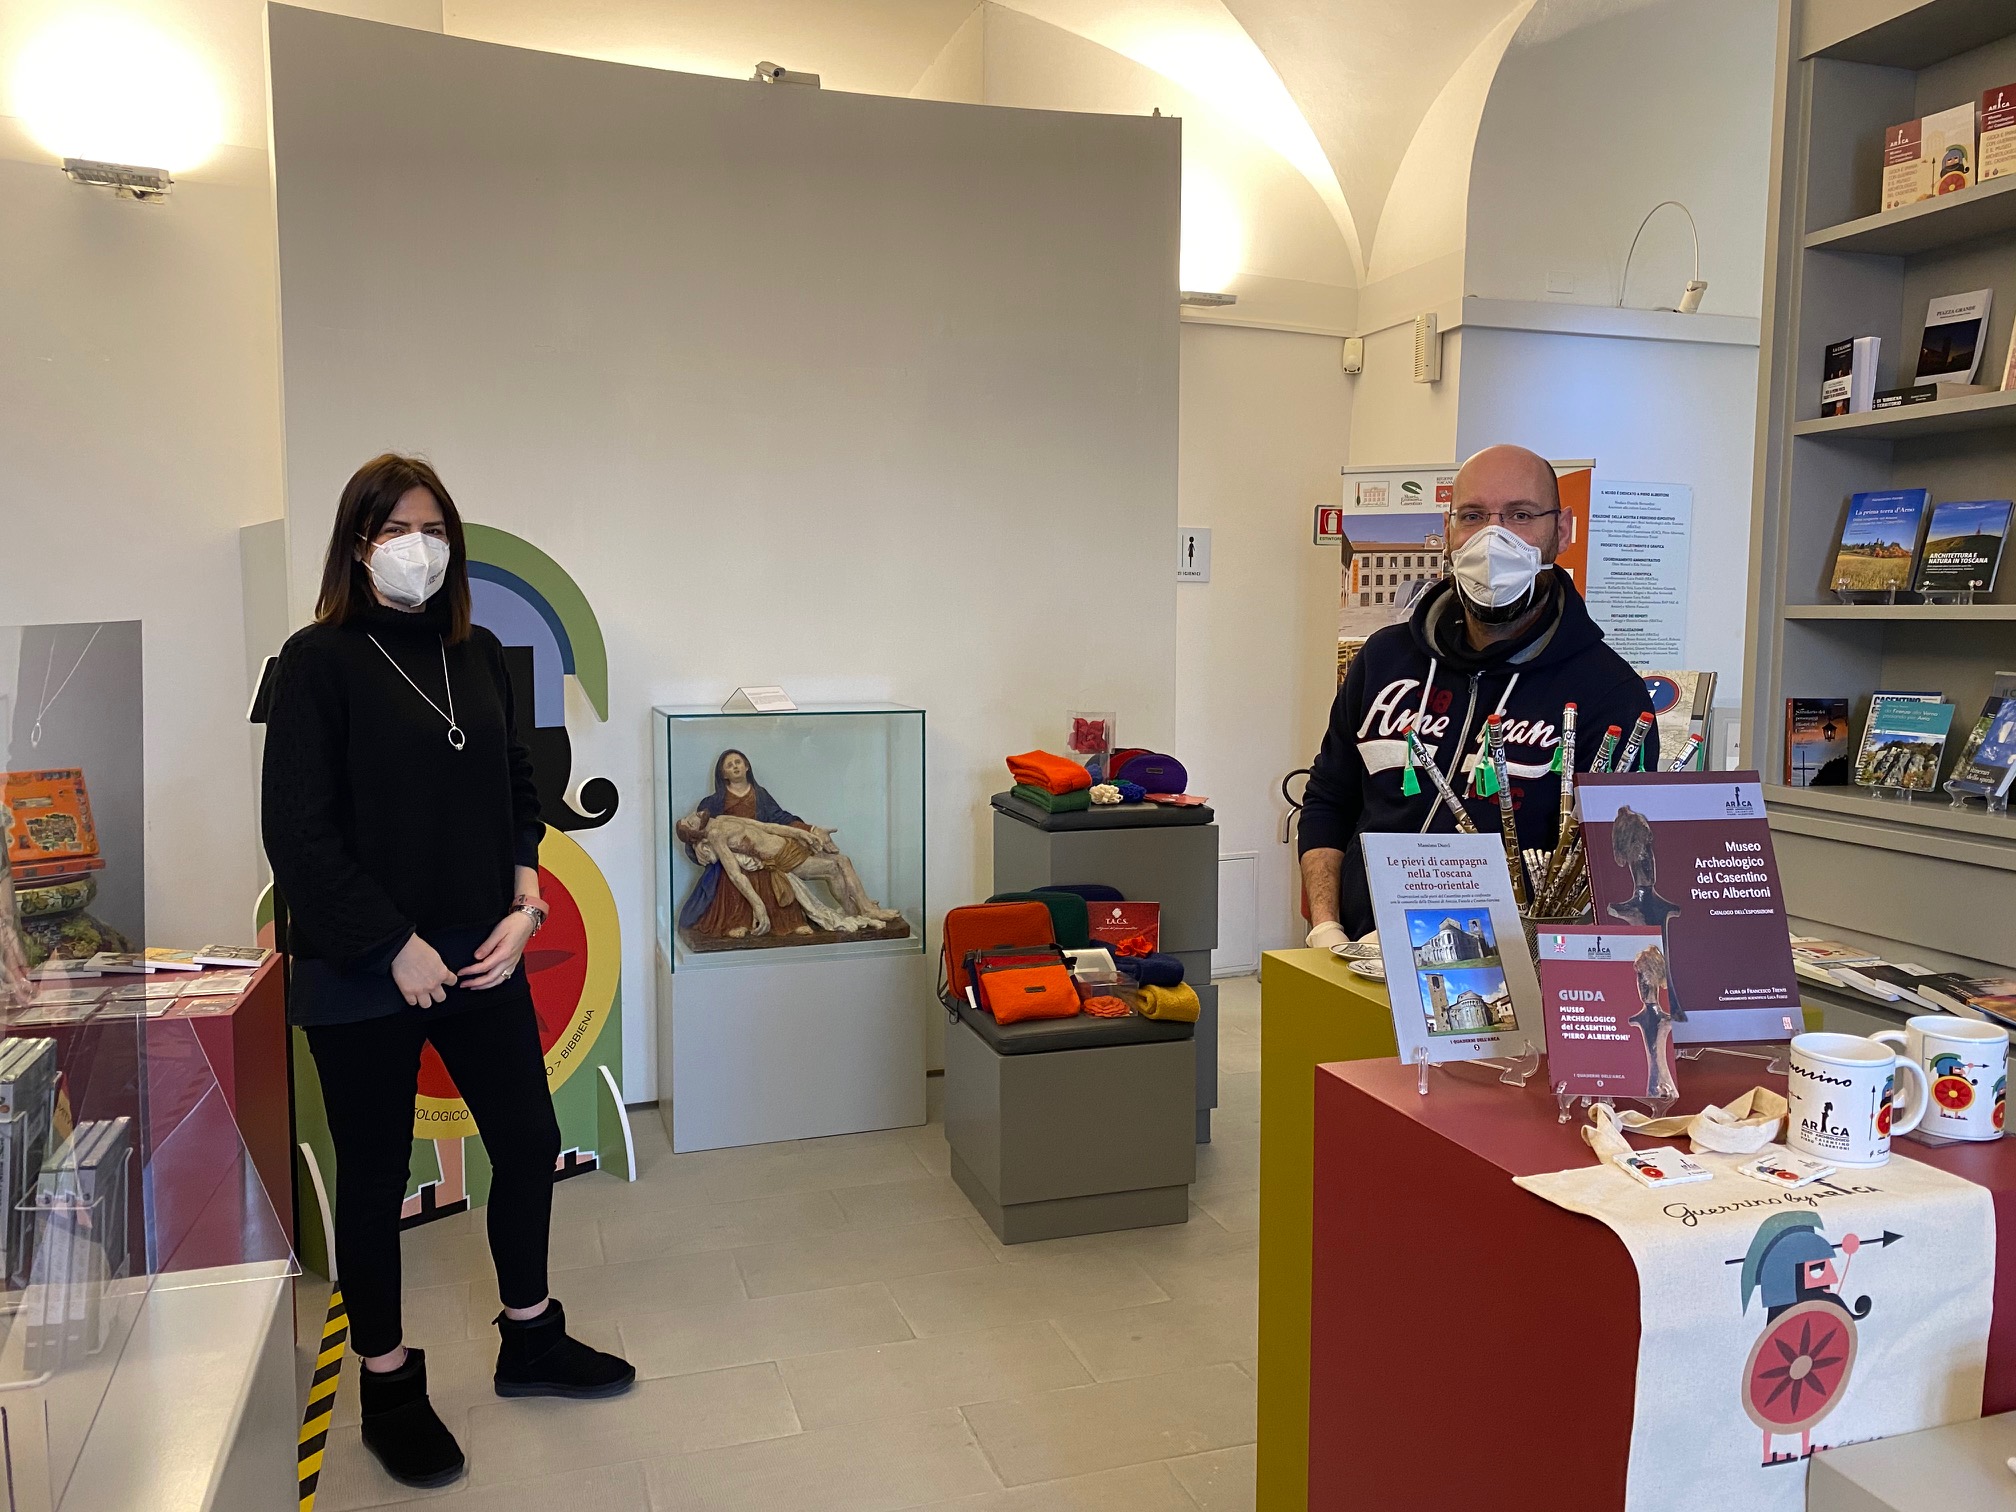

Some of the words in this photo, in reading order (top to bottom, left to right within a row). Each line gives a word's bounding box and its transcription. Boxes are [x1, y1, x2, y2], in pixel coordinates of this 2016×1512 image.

[1725, 842, 1761, 852] Museo
[1386, 856, 1399, 866] Le
[1401, 856, 1425, 868] pievi
[1427, 856, 1437, 866] di
[1440, 857, 1488, 868] campagna
[1695, 857, 1764, 870] Archeologico
[1407, 869, 1431, 878] nella
[1432, 868, 1472, 878] Toscana
[1697, 873, 1713, 884] del
[1715, 872, 1767, 884] Casentino
[1404, 880, 1480, 890] centro-orientale
[1691, 888, 1720, 900] Piero
[1722, 887, 1771, 899] Albertoni
[1558, 989, 1605, 1002] GUIDA
[1561, 1015, 1616, 1023] ARCHEOLOGICO
[1561, 1023, 1574, 1031] del
[1575, 1024, 1616, 1032] CASENTINO
[561, 1009, 595, 1059] BIBBIENA
[414, 1107, 469, 1122] OLOGICO
[1663, 1196, 1782, 1227] Guerrino
[1783, 1192, 1816, 1207] by
